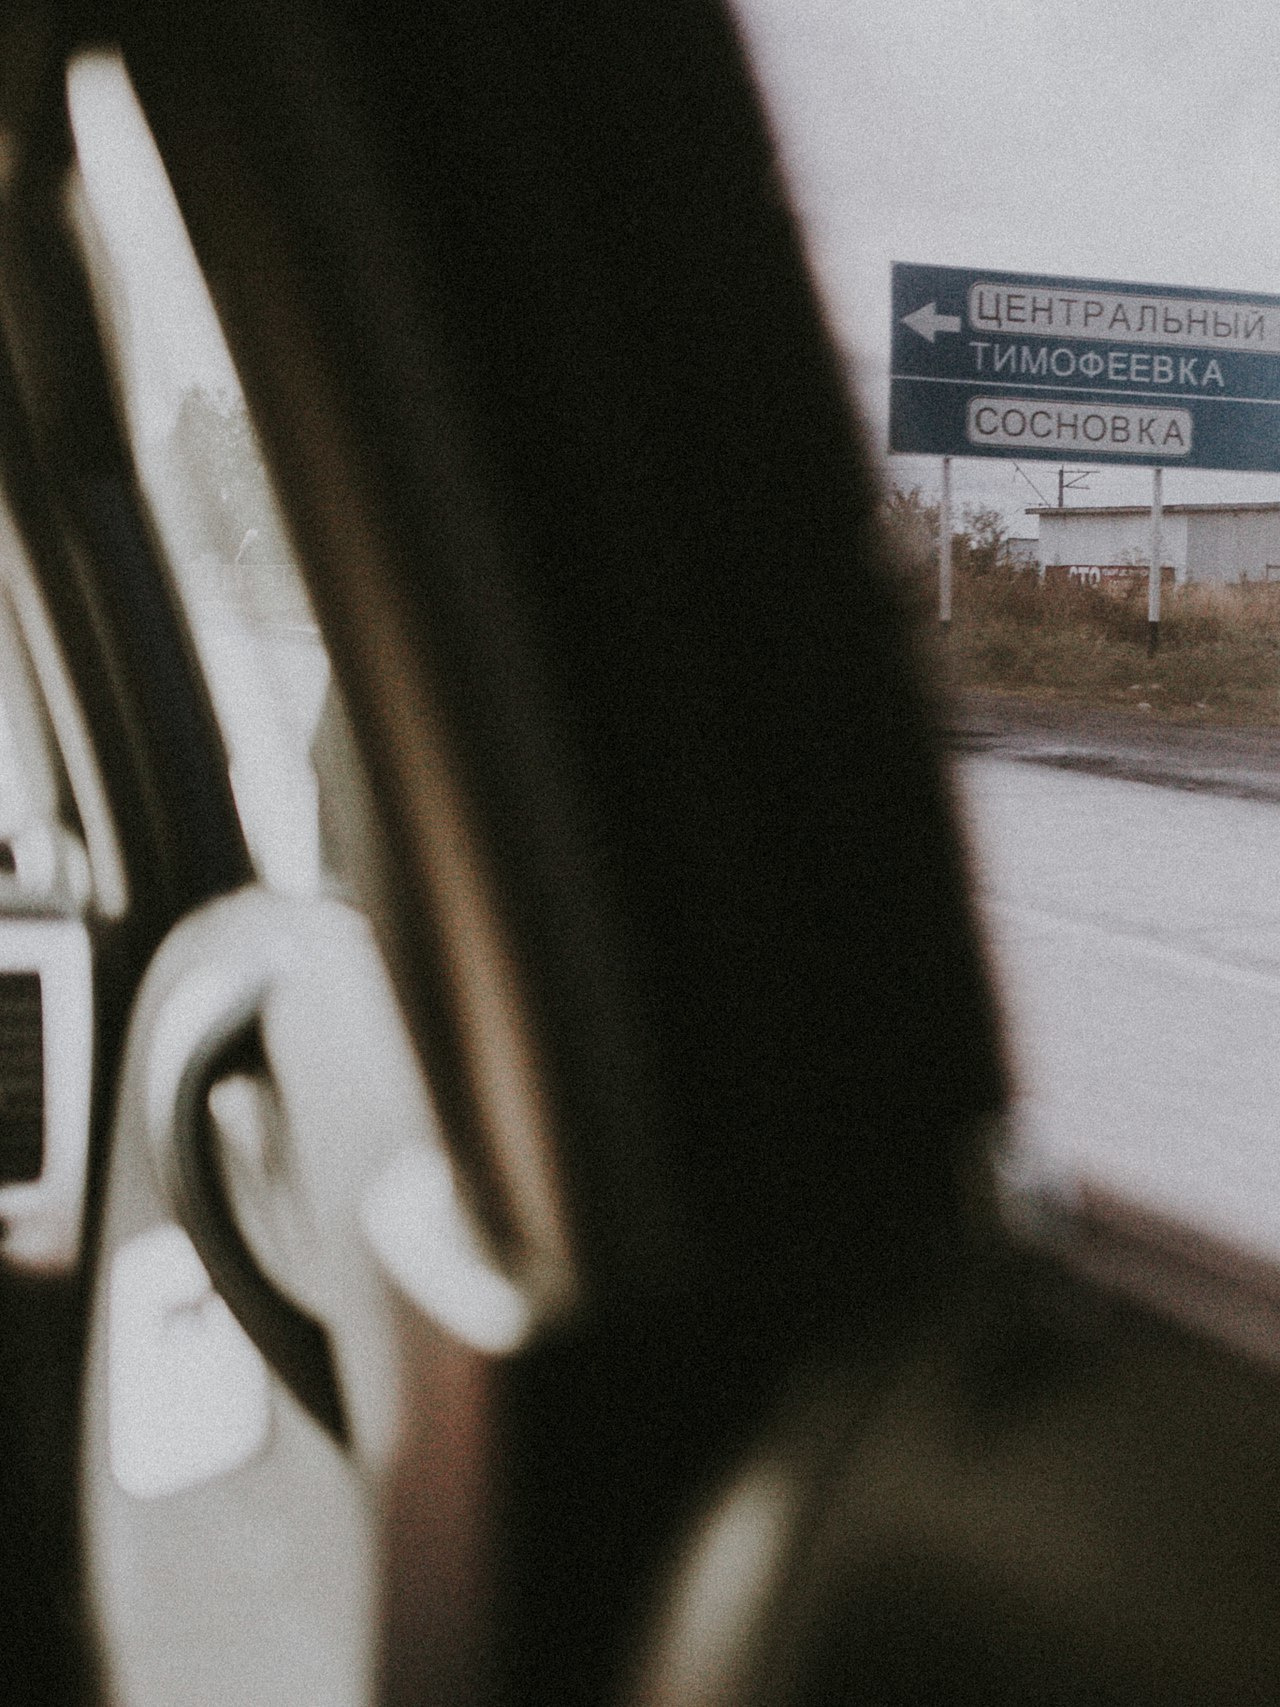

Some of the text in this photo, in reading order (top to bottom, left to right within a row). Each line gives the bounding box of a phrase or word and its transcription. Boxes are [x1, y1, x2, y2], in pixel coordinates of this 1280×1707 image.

[976, 292, 1266, 341] ЦЕНТРАЛЬНЫЙ
[969, 341, 1225, 388] ТИМОФЕЕВКА
[974, 406, 1186, 447] СОСНОВКА
